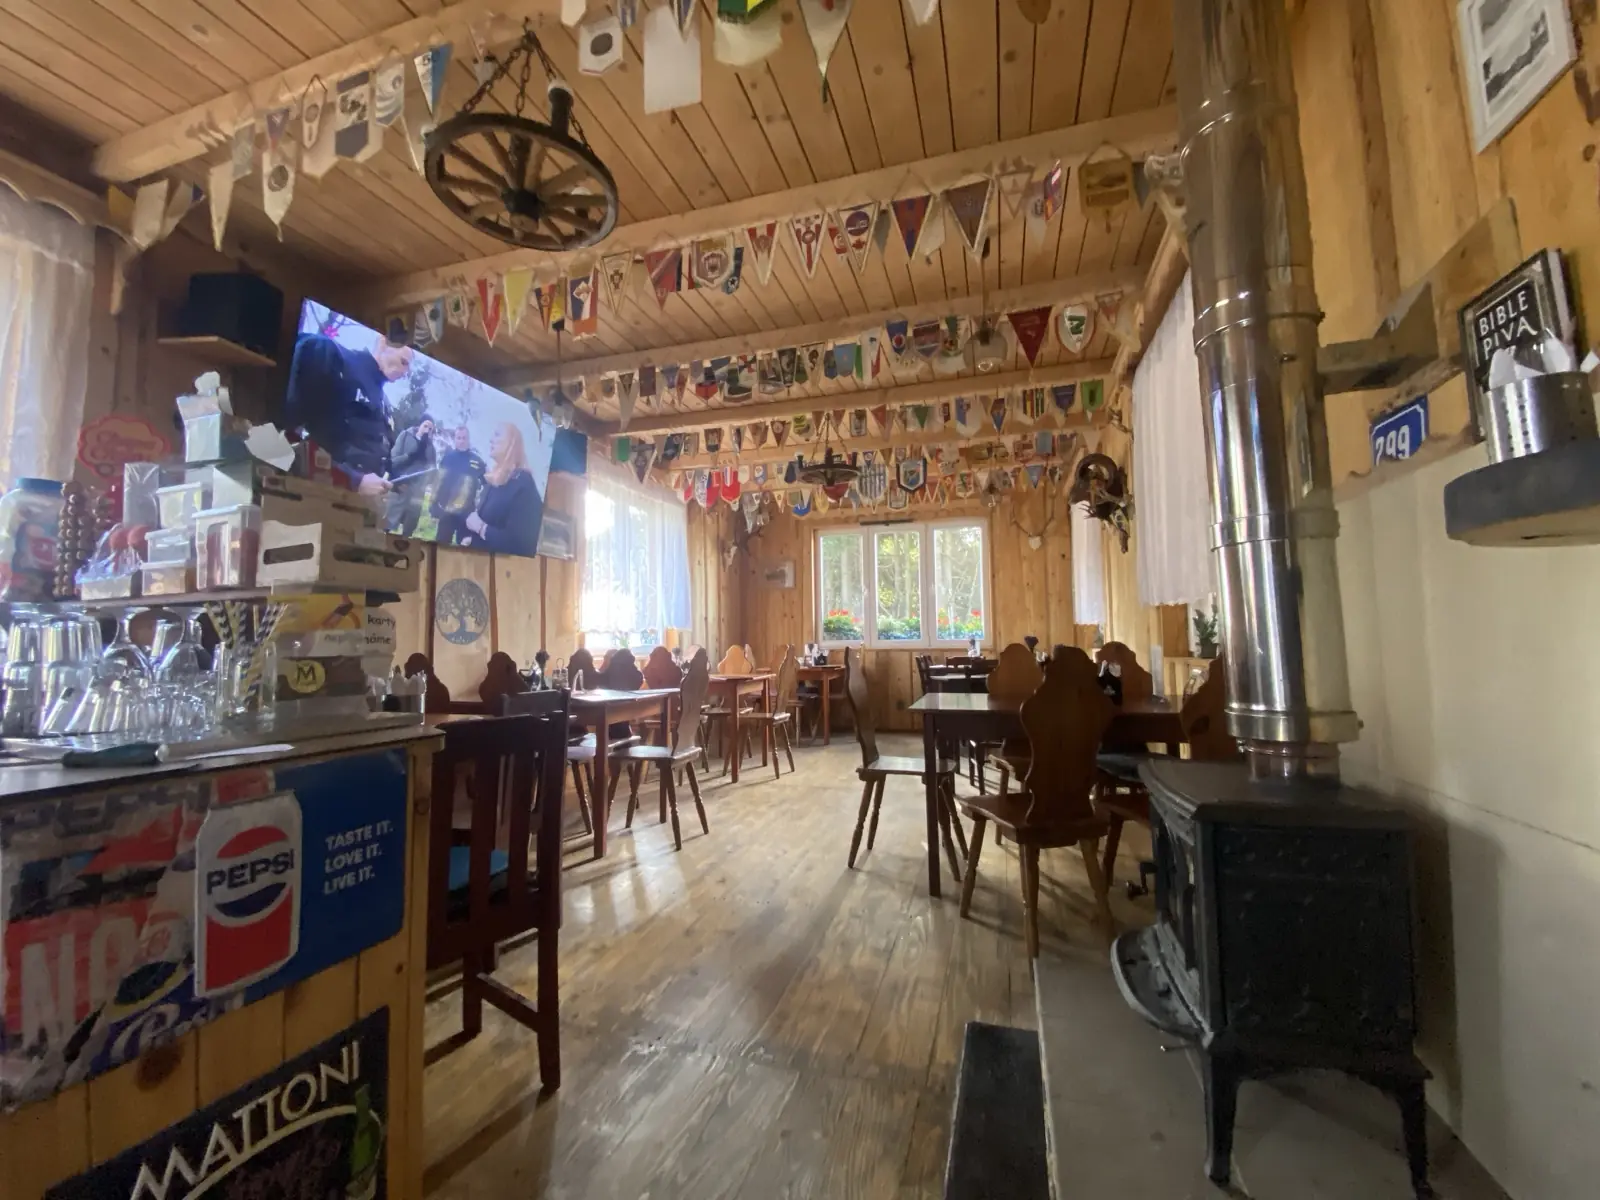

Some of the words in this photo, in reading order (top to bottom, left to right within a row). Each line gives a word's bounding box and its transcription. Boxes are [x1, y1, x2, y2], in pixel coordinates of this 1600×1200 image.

[1479, 290, 1529, 336] BIBLE
[1483, 316, 1538, 360] PIVA
[325, 825, 372, 850] TASTE
[376, 819, 394, 836] IT.
[206, 848, 295, 895] PEPSI
[324, 871, 356, 895] LIVE
[359, 865, 375, 883] IT.
[325, 848, 363, 873] LOVE
[366, 843, 382, 859] IT.
[130, 1040, 360, 1200] MATTONI
